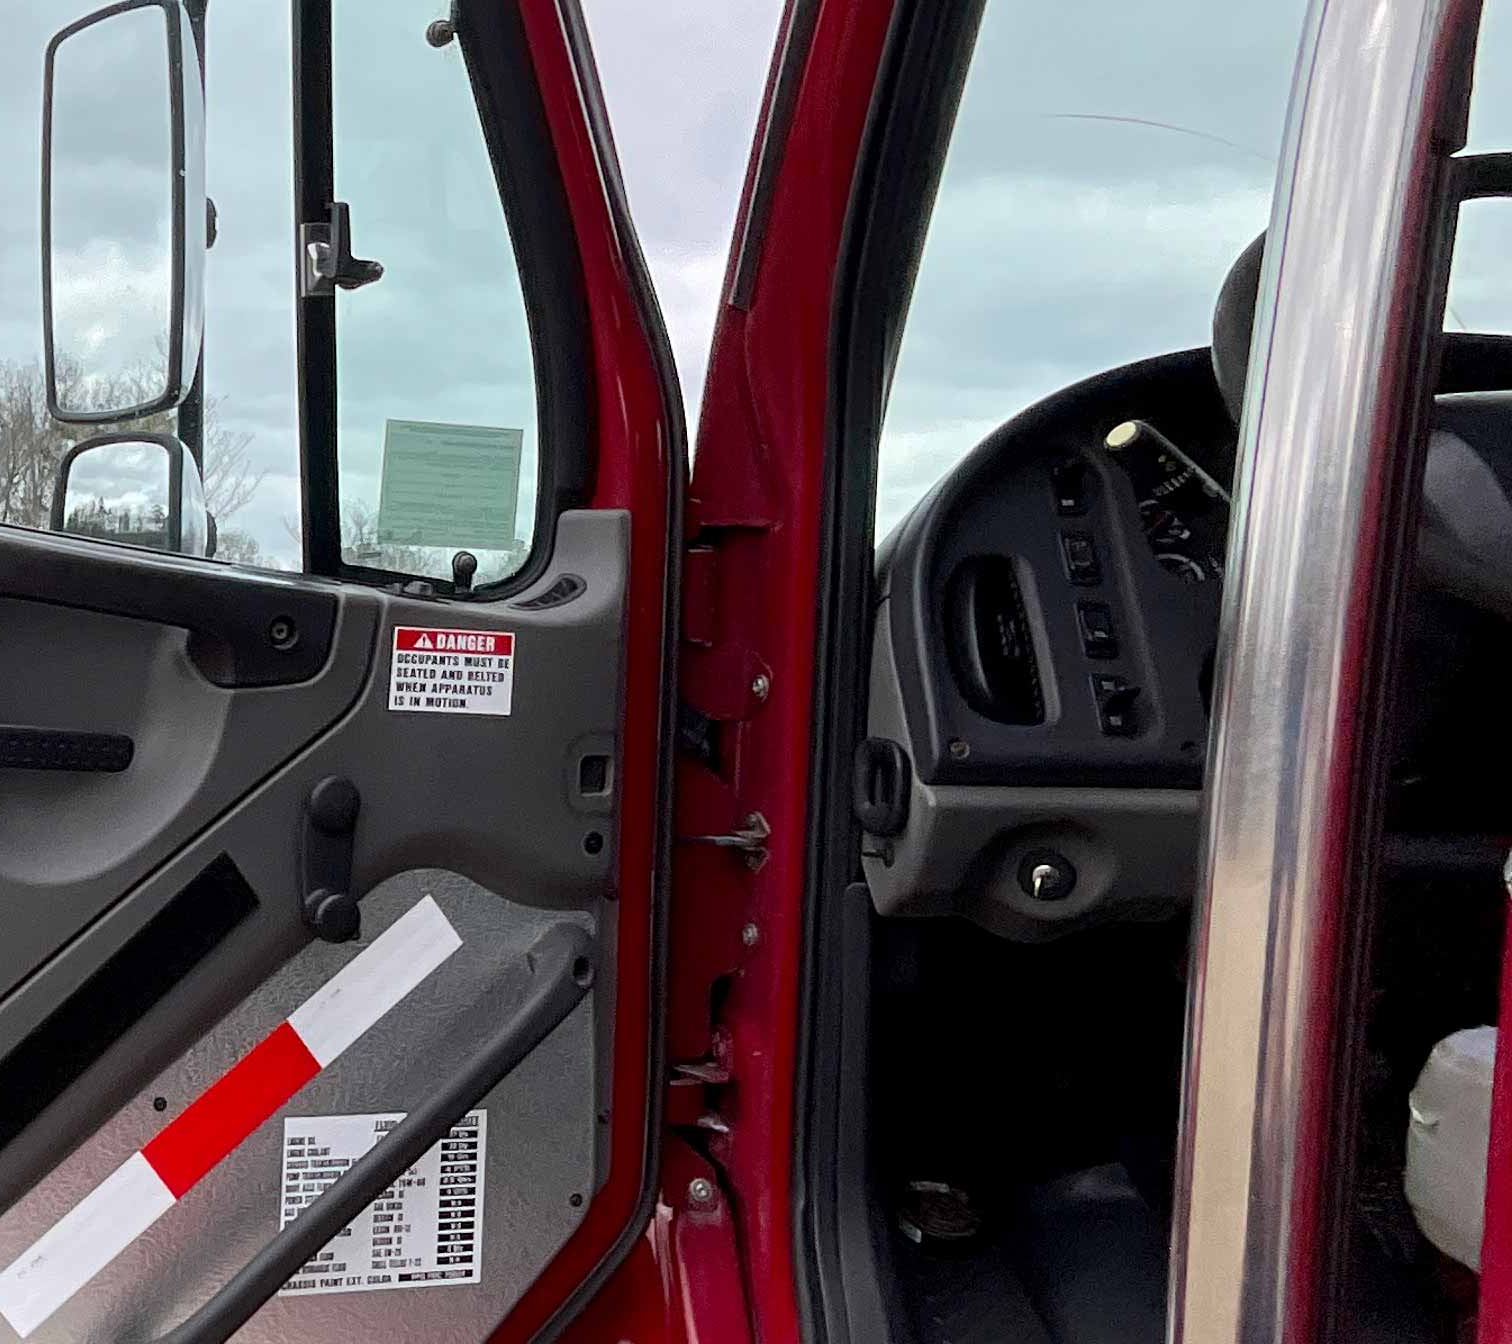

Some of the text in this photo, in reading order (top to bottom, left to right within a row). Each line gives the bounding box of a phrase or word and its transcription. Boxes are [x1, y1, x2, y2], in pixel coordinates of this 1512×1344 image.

[437, 634, 495, 652] DANGER
[397, 654, 510, 669] OCCUPANTS MUST BE
[396, 667, 505, 683] SEATED AND BELTED
[396, 682, 493, 696] WHEN APPARATUS
[394, 696, 405, 706] IS
[409, 697, 421, 706] IN
[320, 1278, 343, 1288] PAINT
